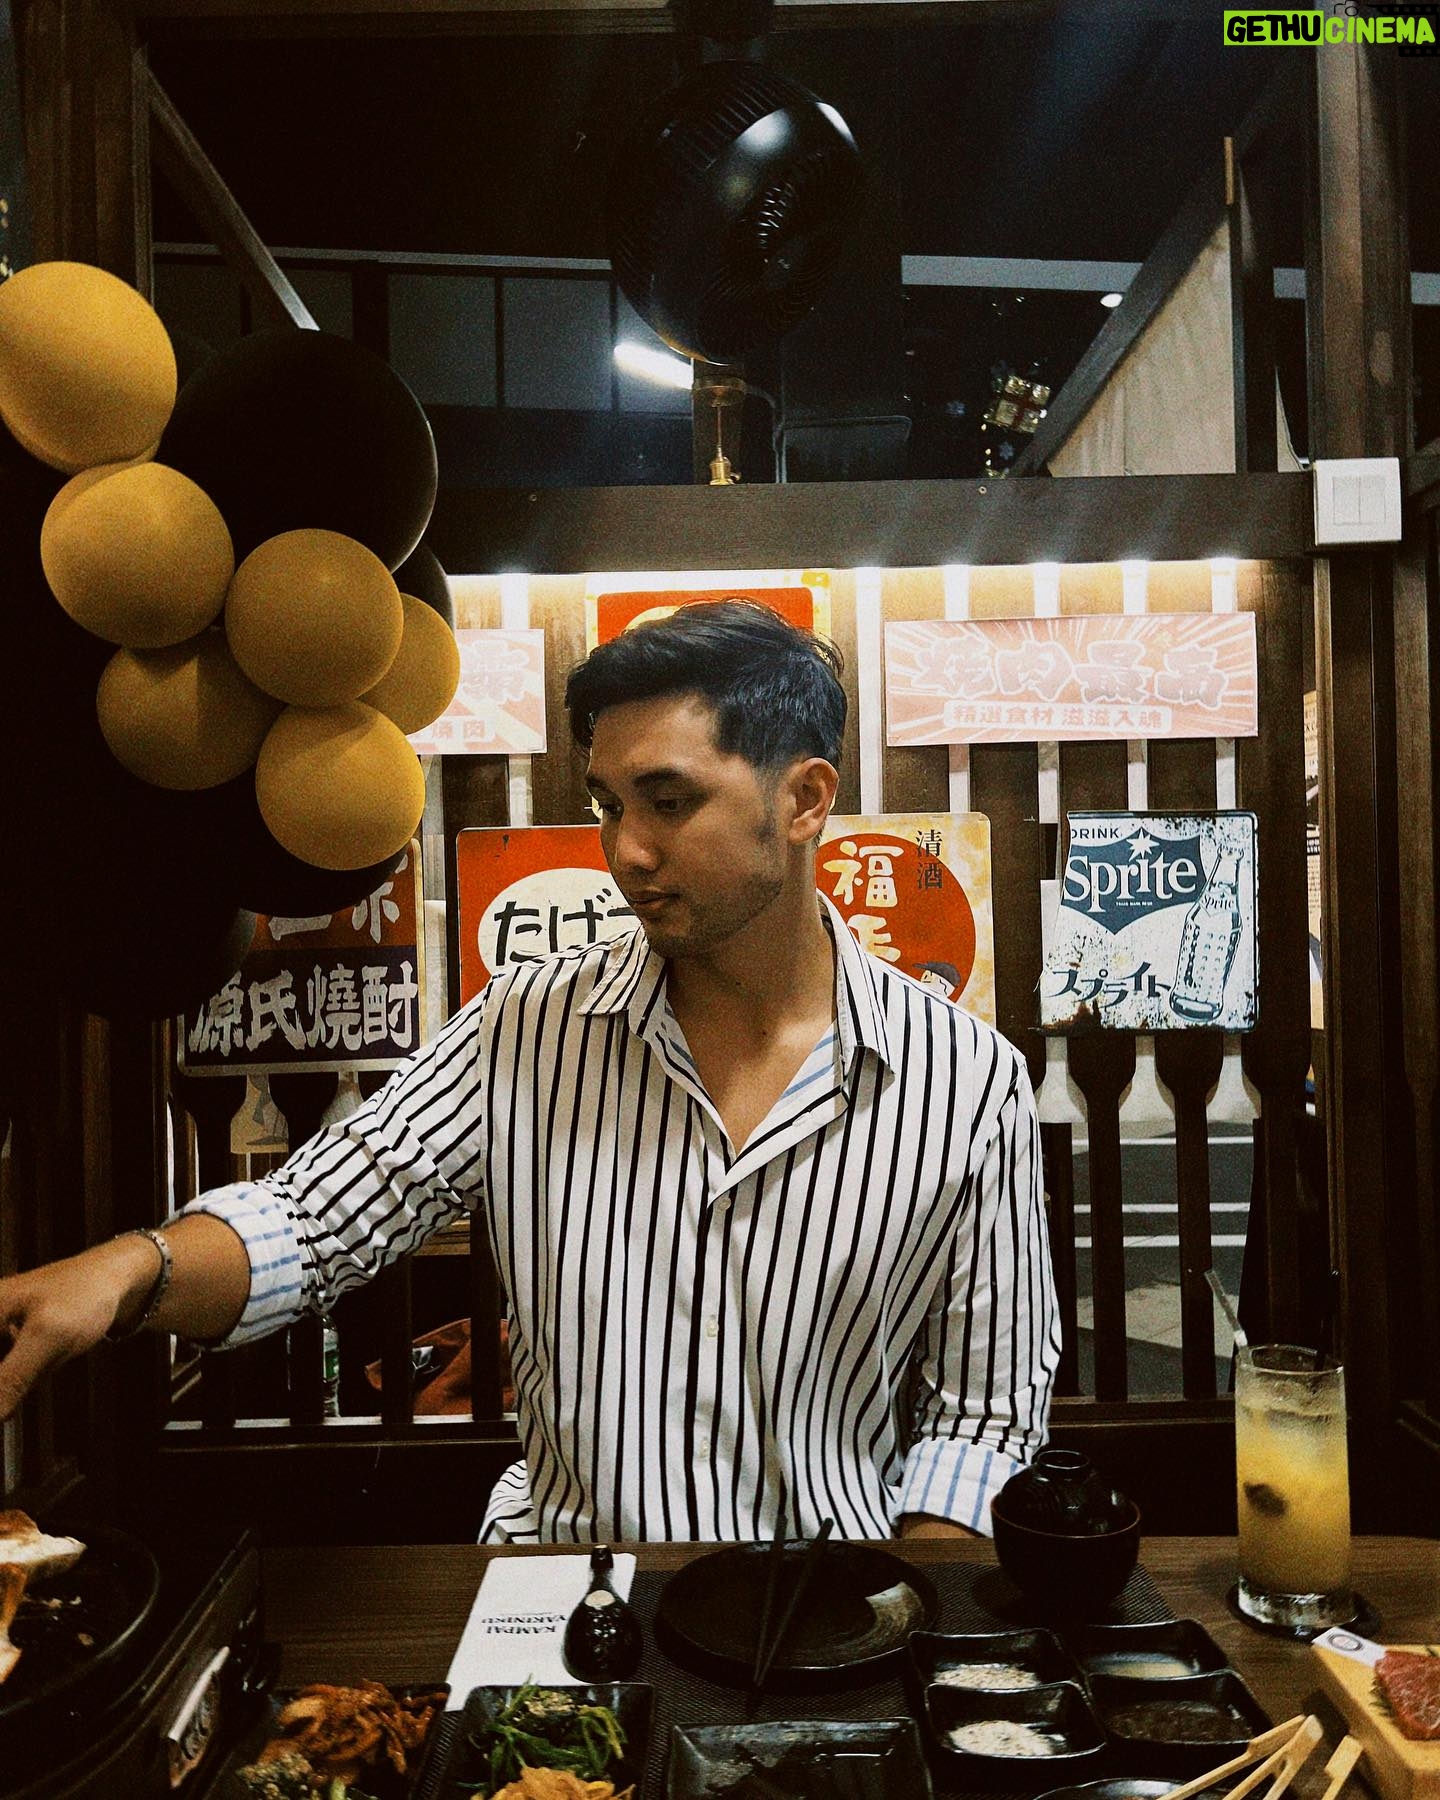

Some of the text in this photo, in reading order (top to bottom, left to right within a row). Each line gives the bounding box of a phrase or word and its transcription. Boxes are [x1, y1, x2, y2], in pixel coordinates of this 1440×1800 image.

[915, 829, 943, 889] 清酒
[1063, 848, 1197, 913] Sprite
[1045, 961, 1172, 1009] スプライト
[485, 1625, 556, 1634] KAMPAI
